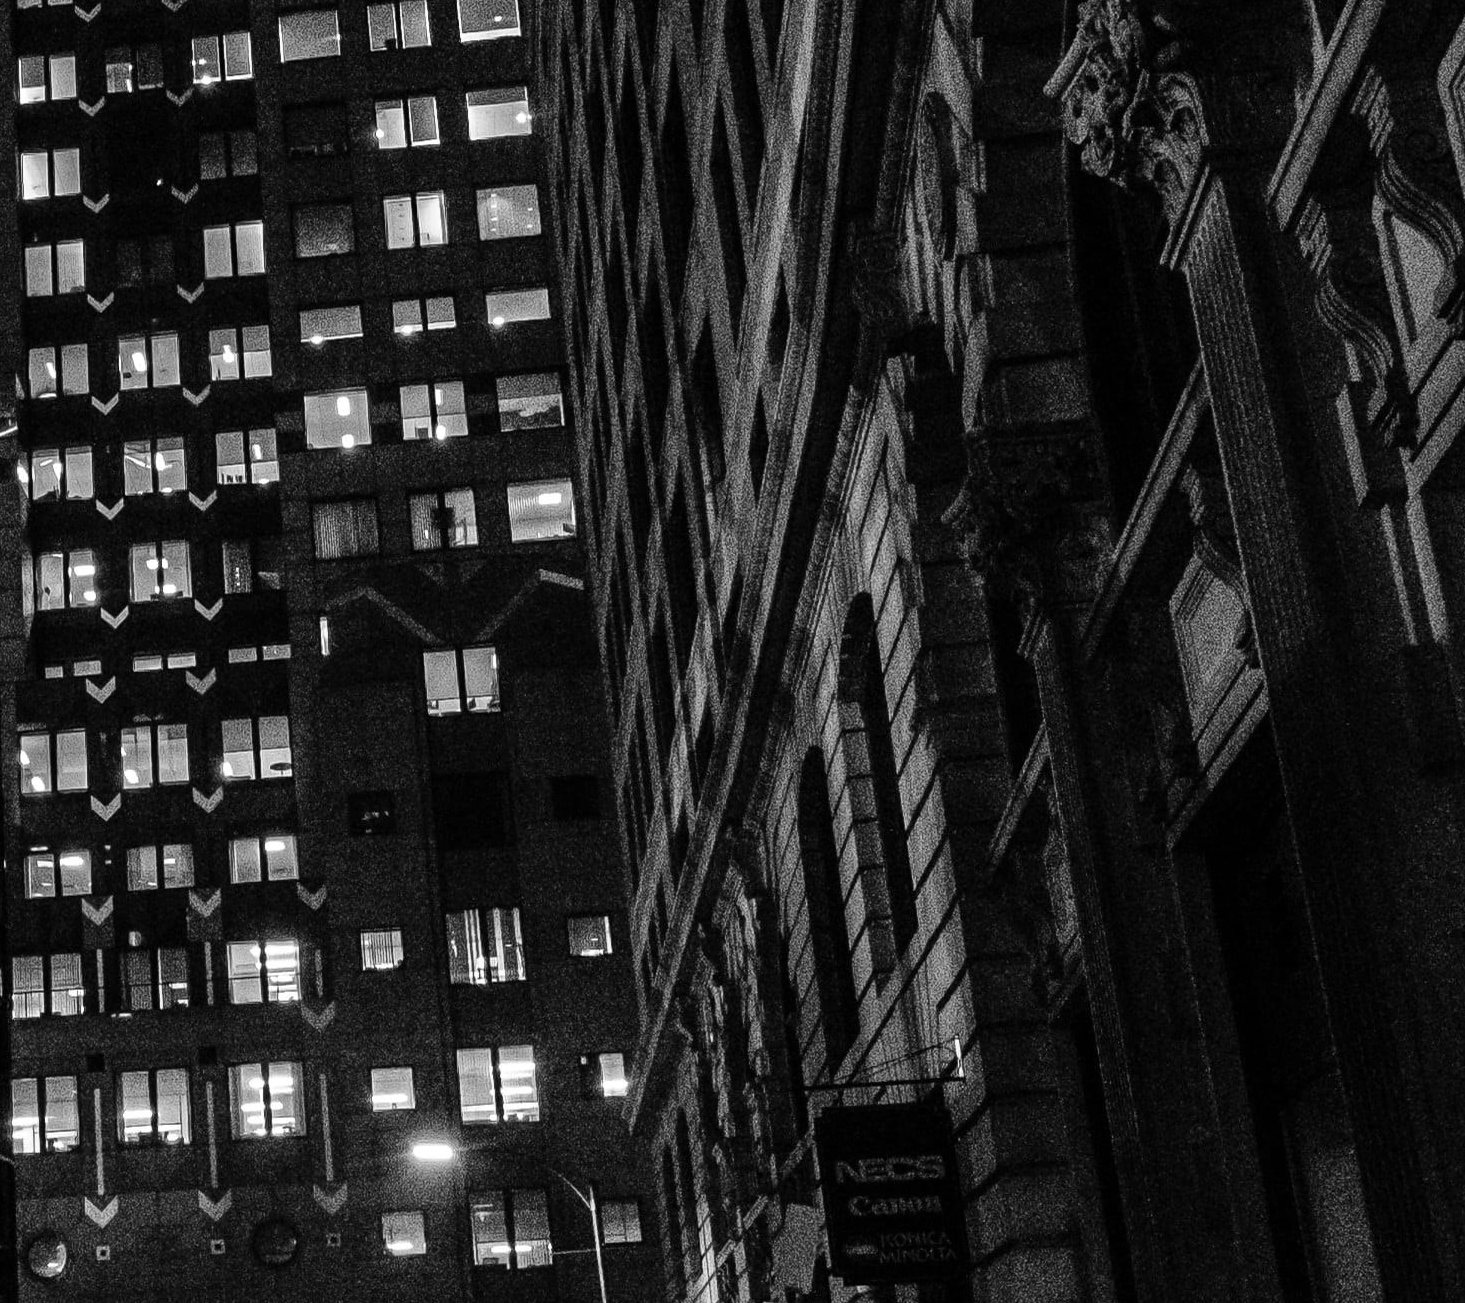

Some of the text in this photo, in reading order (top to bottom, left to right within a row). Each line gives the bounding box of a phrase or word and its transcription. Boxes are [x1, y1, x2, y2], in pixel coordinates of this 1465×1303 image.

[835, 1154, 946, 1184] NECS
[848, 1195, 942, 1217] Canon
[880, 1230, 953, 1248] KONICA
[879, 1246, 958, 1264] MINOLTA
